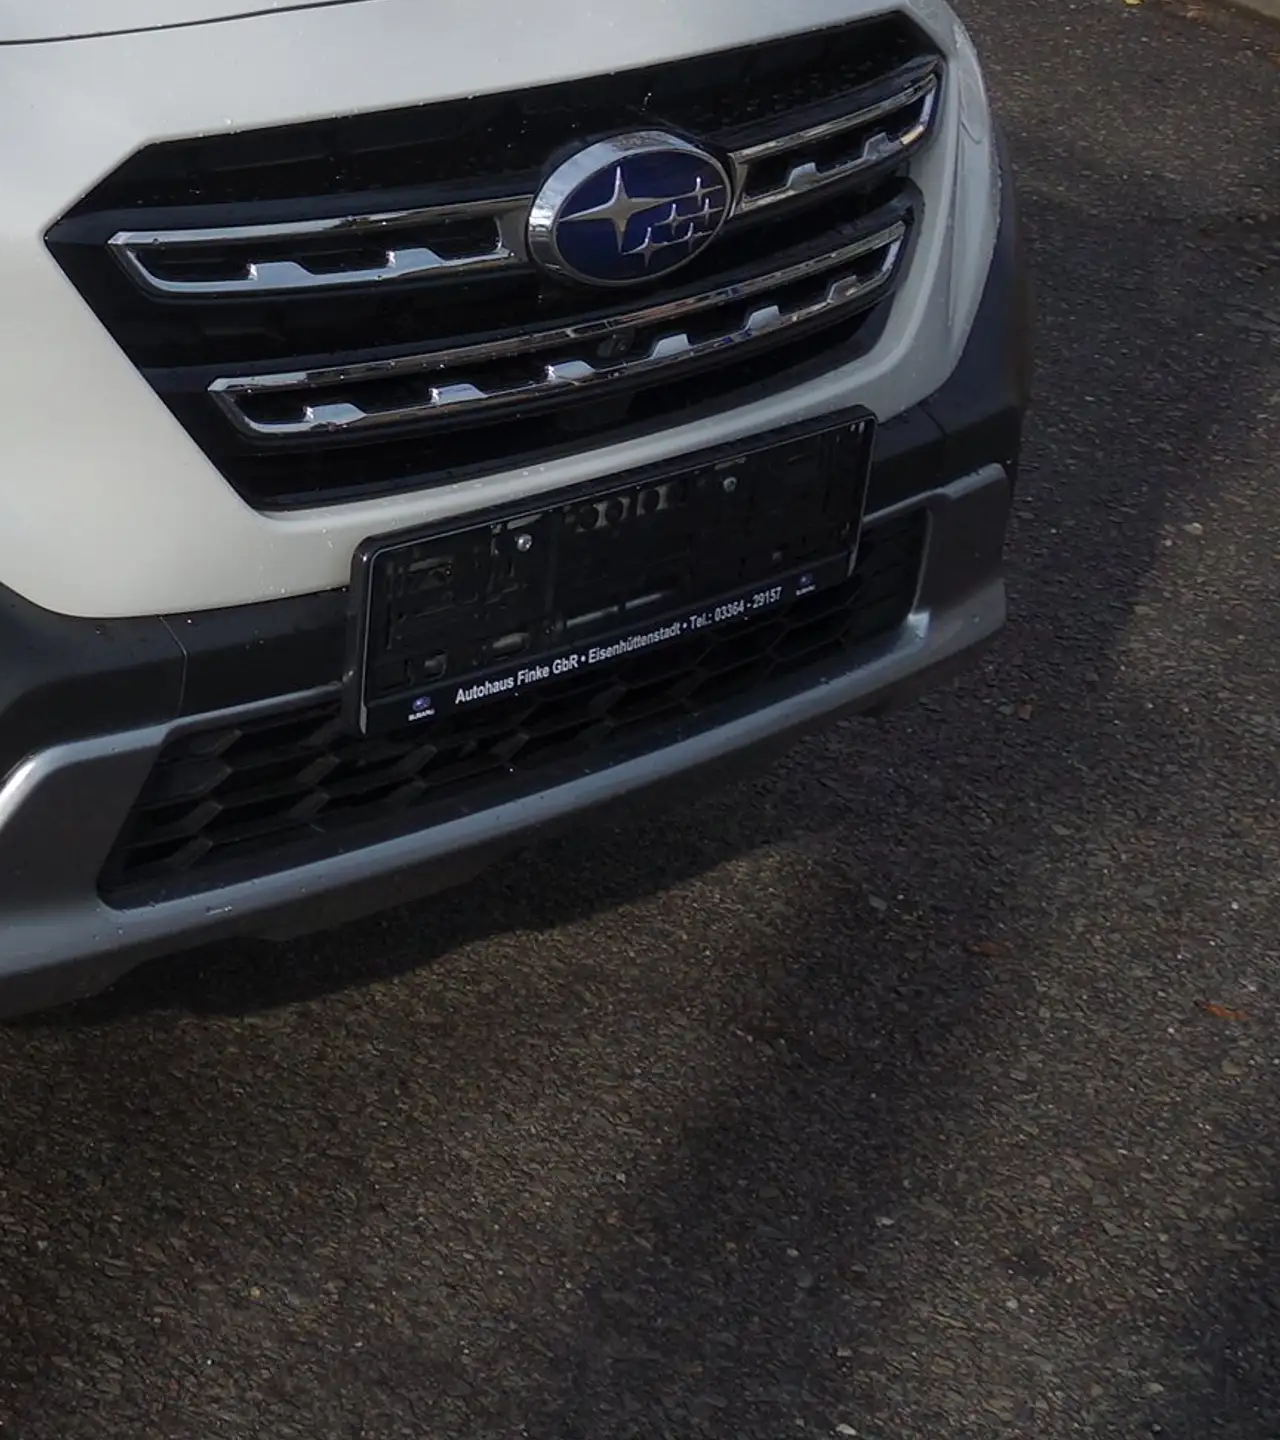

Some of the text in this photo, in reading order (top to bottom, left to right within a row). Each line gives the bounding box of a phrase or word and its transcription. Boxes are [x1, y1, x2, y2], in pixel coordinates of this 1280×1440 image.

[455, 676, 514, 704] Autohaus
[517, 664, 550, 686] Finke
[552, 653, 579, 675] GbR
[588, 621, 681, 664] Eisenhüttenstadt
[689, 612, 713, 630] Tel.:
[714, 599, 745, 622] 03364
[752, 586, 783, 609] 29157
